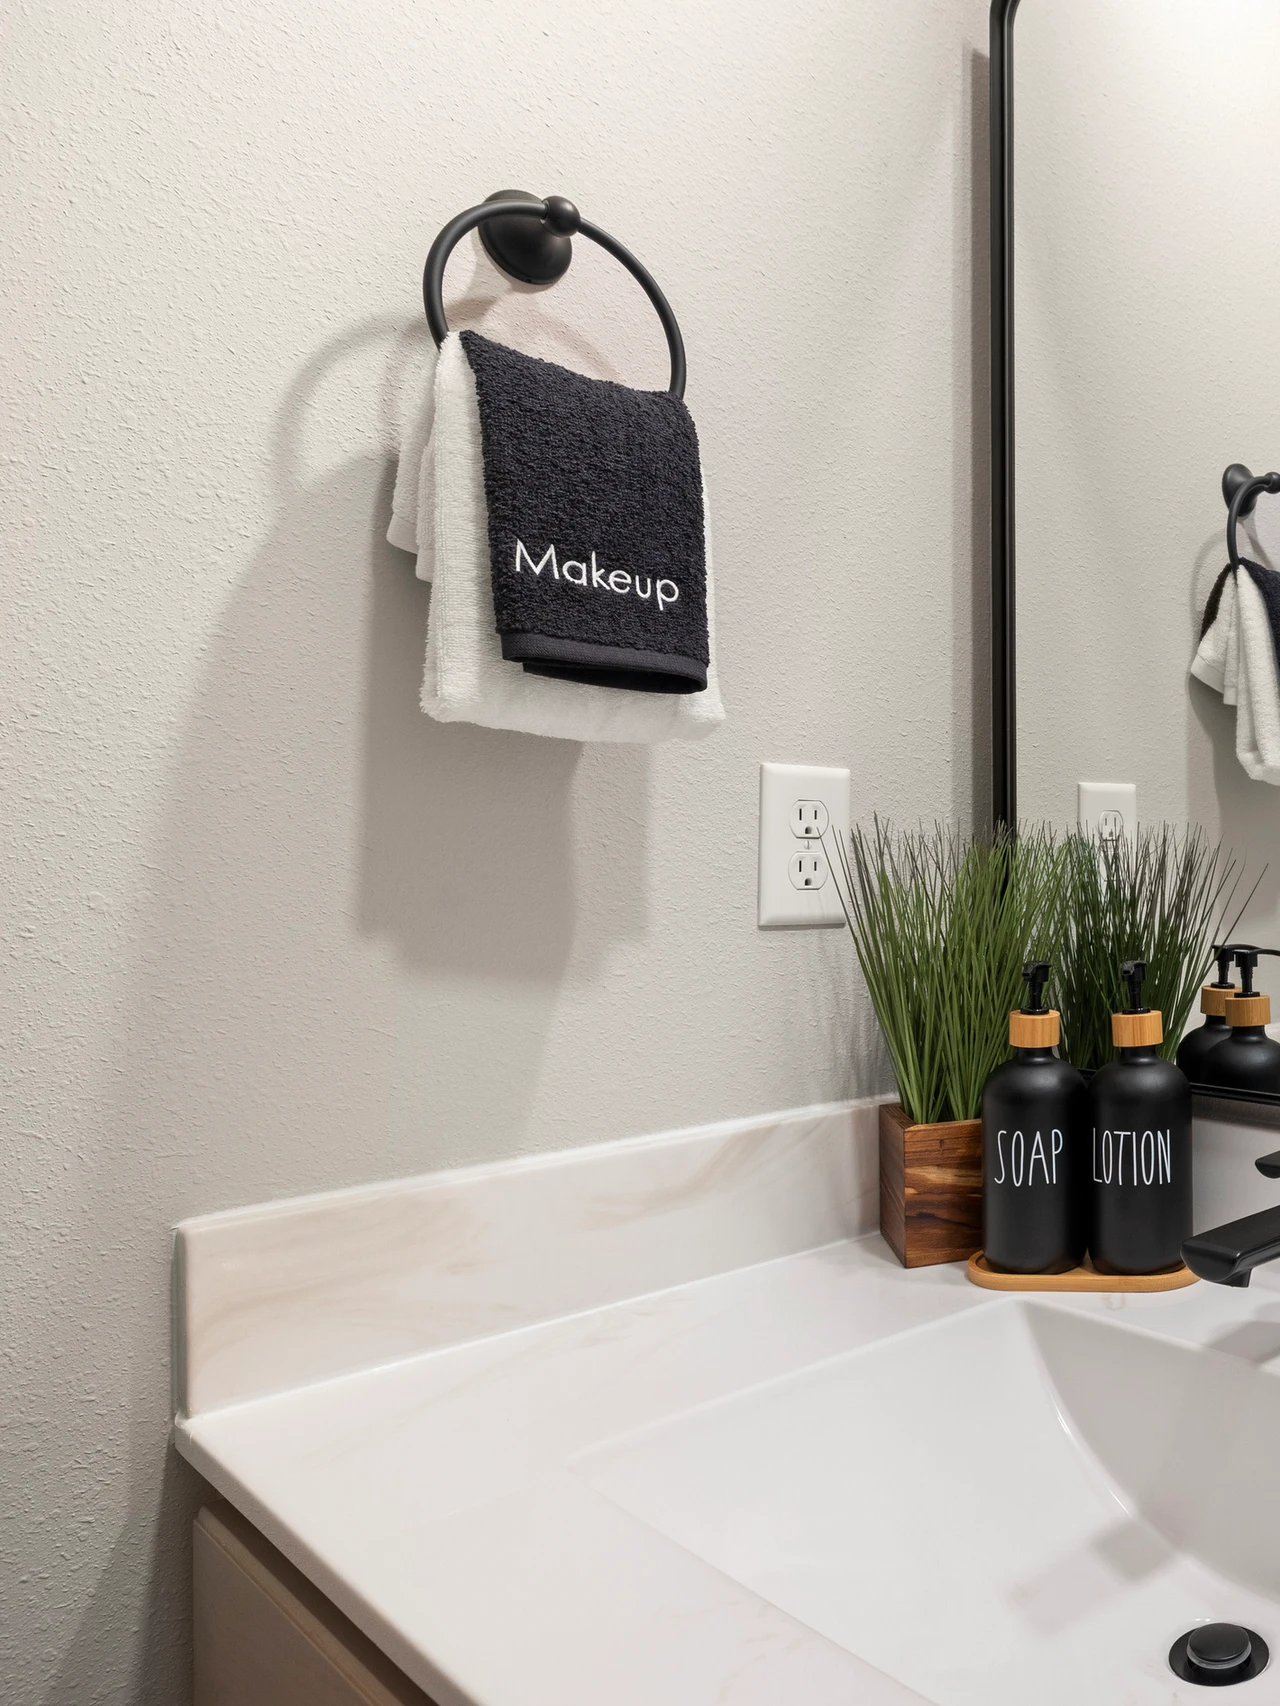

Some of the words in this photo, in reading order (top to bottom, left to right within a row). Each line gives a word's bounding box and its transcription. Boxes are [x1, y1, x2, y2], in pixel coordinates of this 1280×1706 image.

[515, 538, 679, 611] Makeup
[994, 1128, 1063, 1187] SOAP
[1092, 1127, 1171, 1187] LOTION
